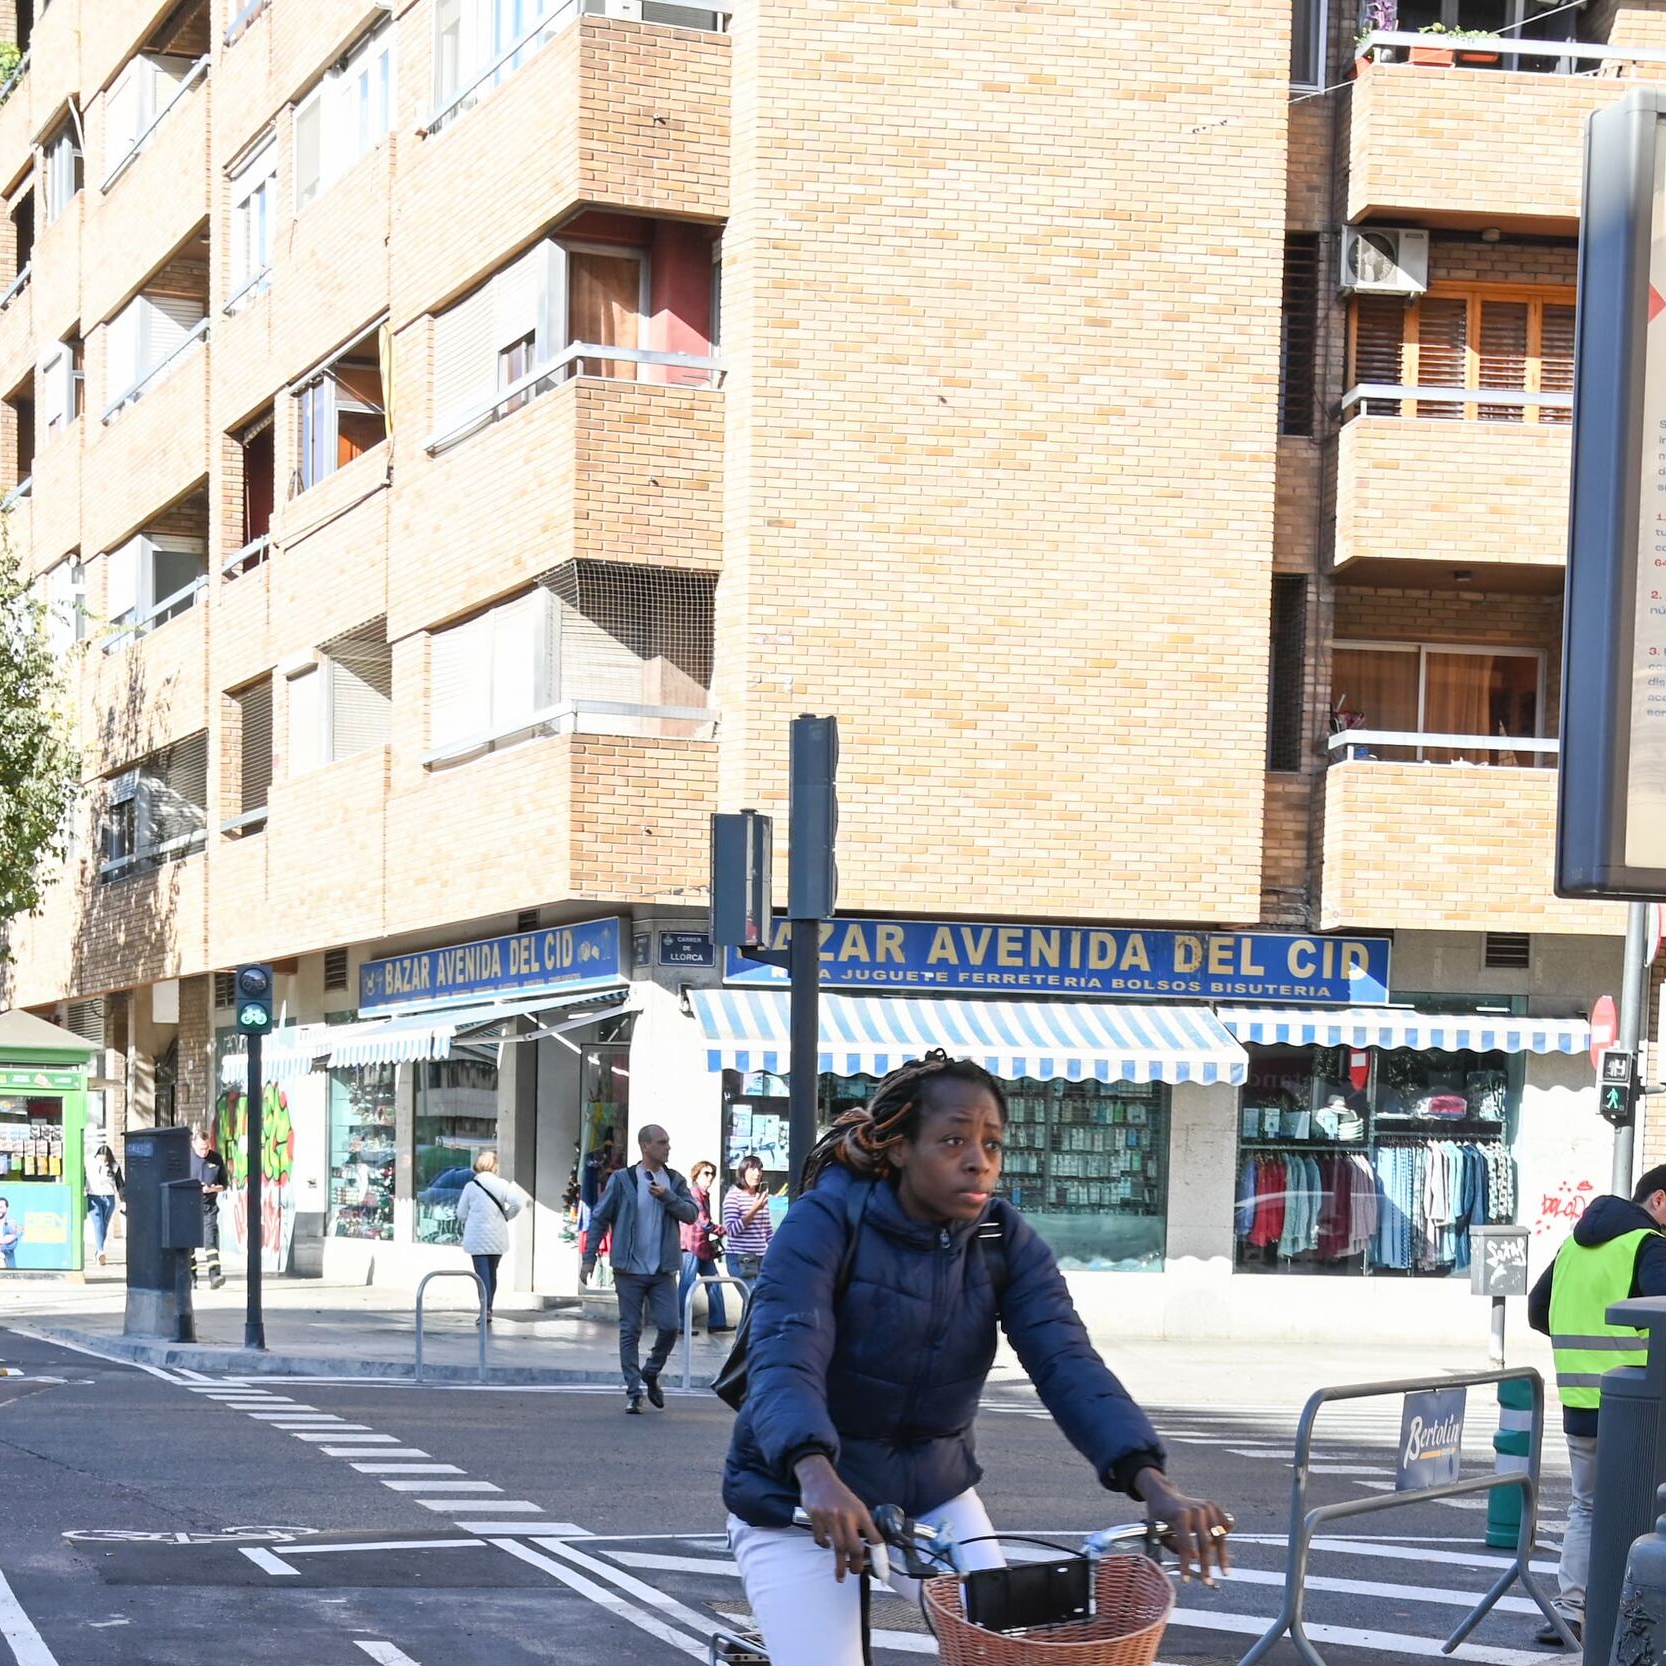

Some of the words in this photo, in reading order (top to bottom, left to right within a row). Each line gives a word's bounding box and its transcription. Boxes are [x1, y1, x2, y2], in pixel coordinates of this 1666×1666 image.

[1651, 591, 1662, 599] 2.
[1648, 647, 1660, 656] 3.
[670, 953, 704, 962] LLORCA
[926, 926, 1151, 973] AVENIDA
[1173, 933, 1265, 977] DEL
[1286, 939, 1370, 981] CID
[385, 955, 430, 996] BAZAR
[436, 942, 502, 987] AVENIDA
[509, 936, 540, 976] DEL
[544, 930, 573, 971] CID
[840, 969, 949, 983] JUGUETE
[958, 972, 1102, 989] FERRETERIA
[1111, 979, 1202, 993] BOLSOS
[1210, 983, 1332, 997] BISUTERIA
